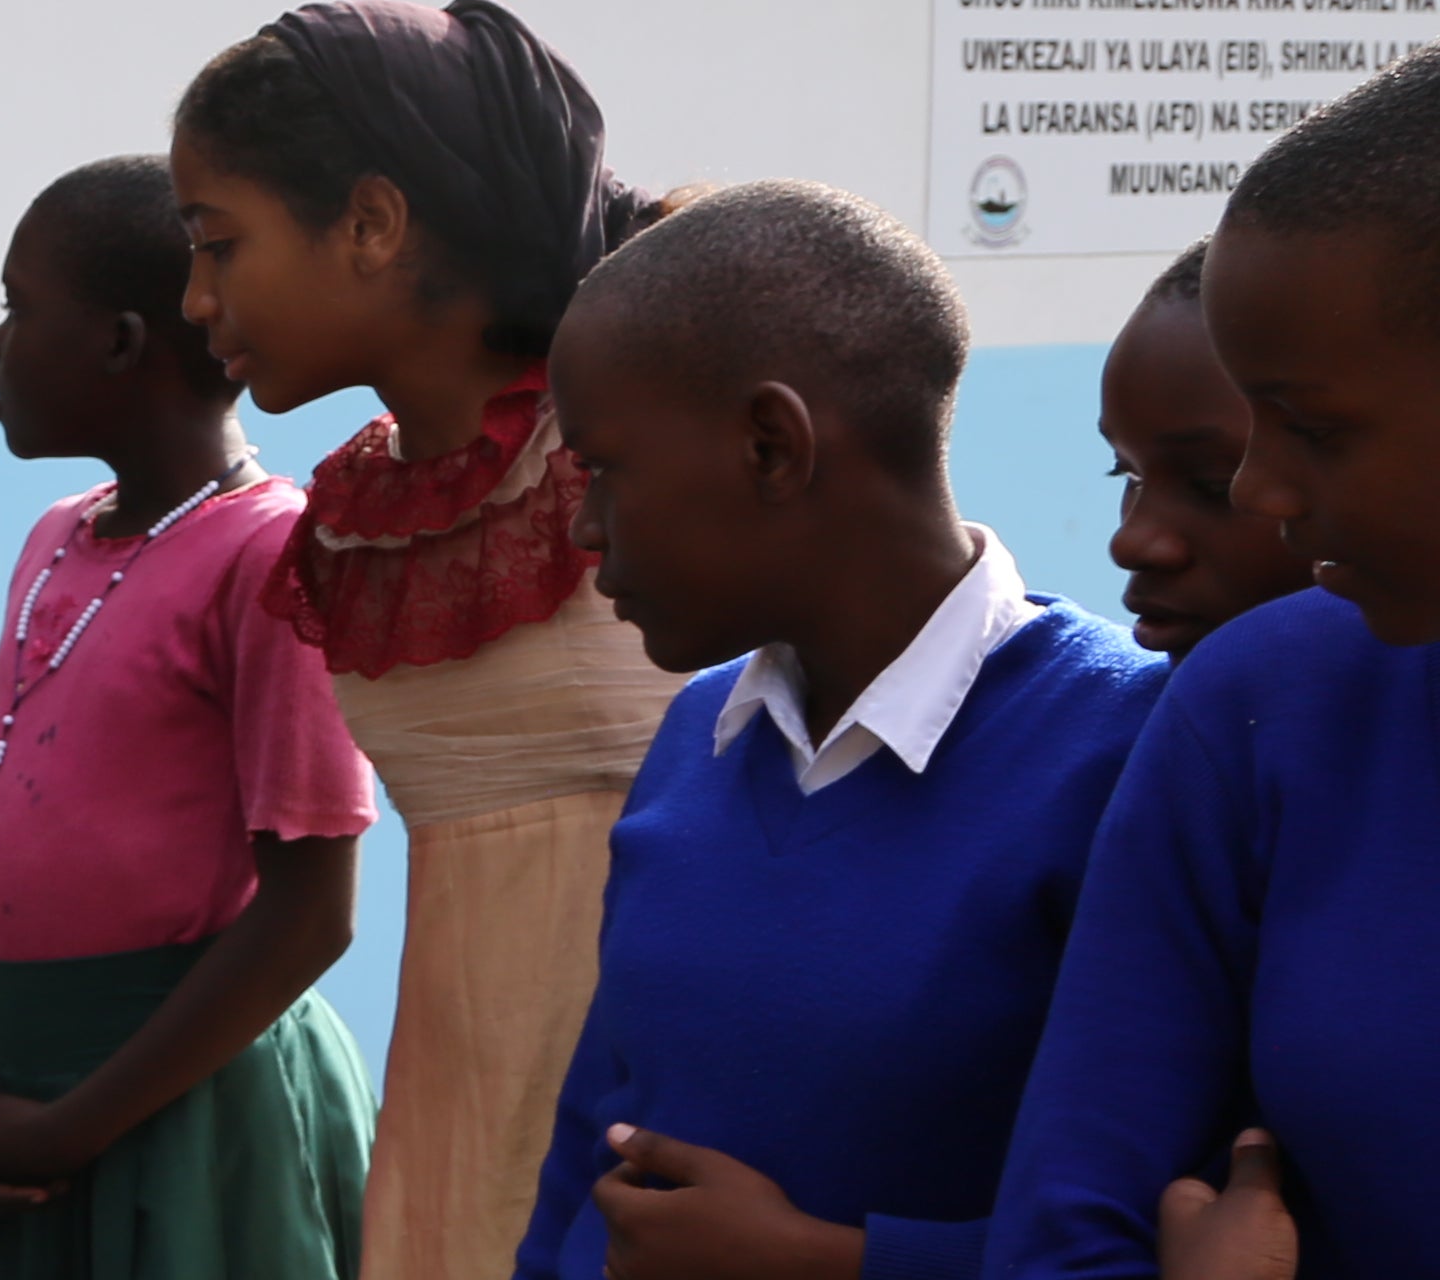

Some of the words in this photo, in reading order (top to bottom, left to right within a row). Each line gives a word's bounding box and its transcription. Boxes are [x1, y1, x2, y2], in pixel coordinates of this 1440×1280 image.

[963, 40, 1096, 71] UWEKEZAJI
[1105, 41, 1131, 71] YA
[1141, 41, 1210, 71] ULAYA
[1218, 41, 1273, 80] (EIB),
[1281, 41, 1366, 71] SHIRIKA
[983, 102, 1010, 134] LA
[1019, 102, 1138, 134] UFARANSA
[1146, 102, 1205, 140] (AFD)
[1212, 102, 1241, 132] NA
[1110, 162, 1241, 194] MUUNGANO
